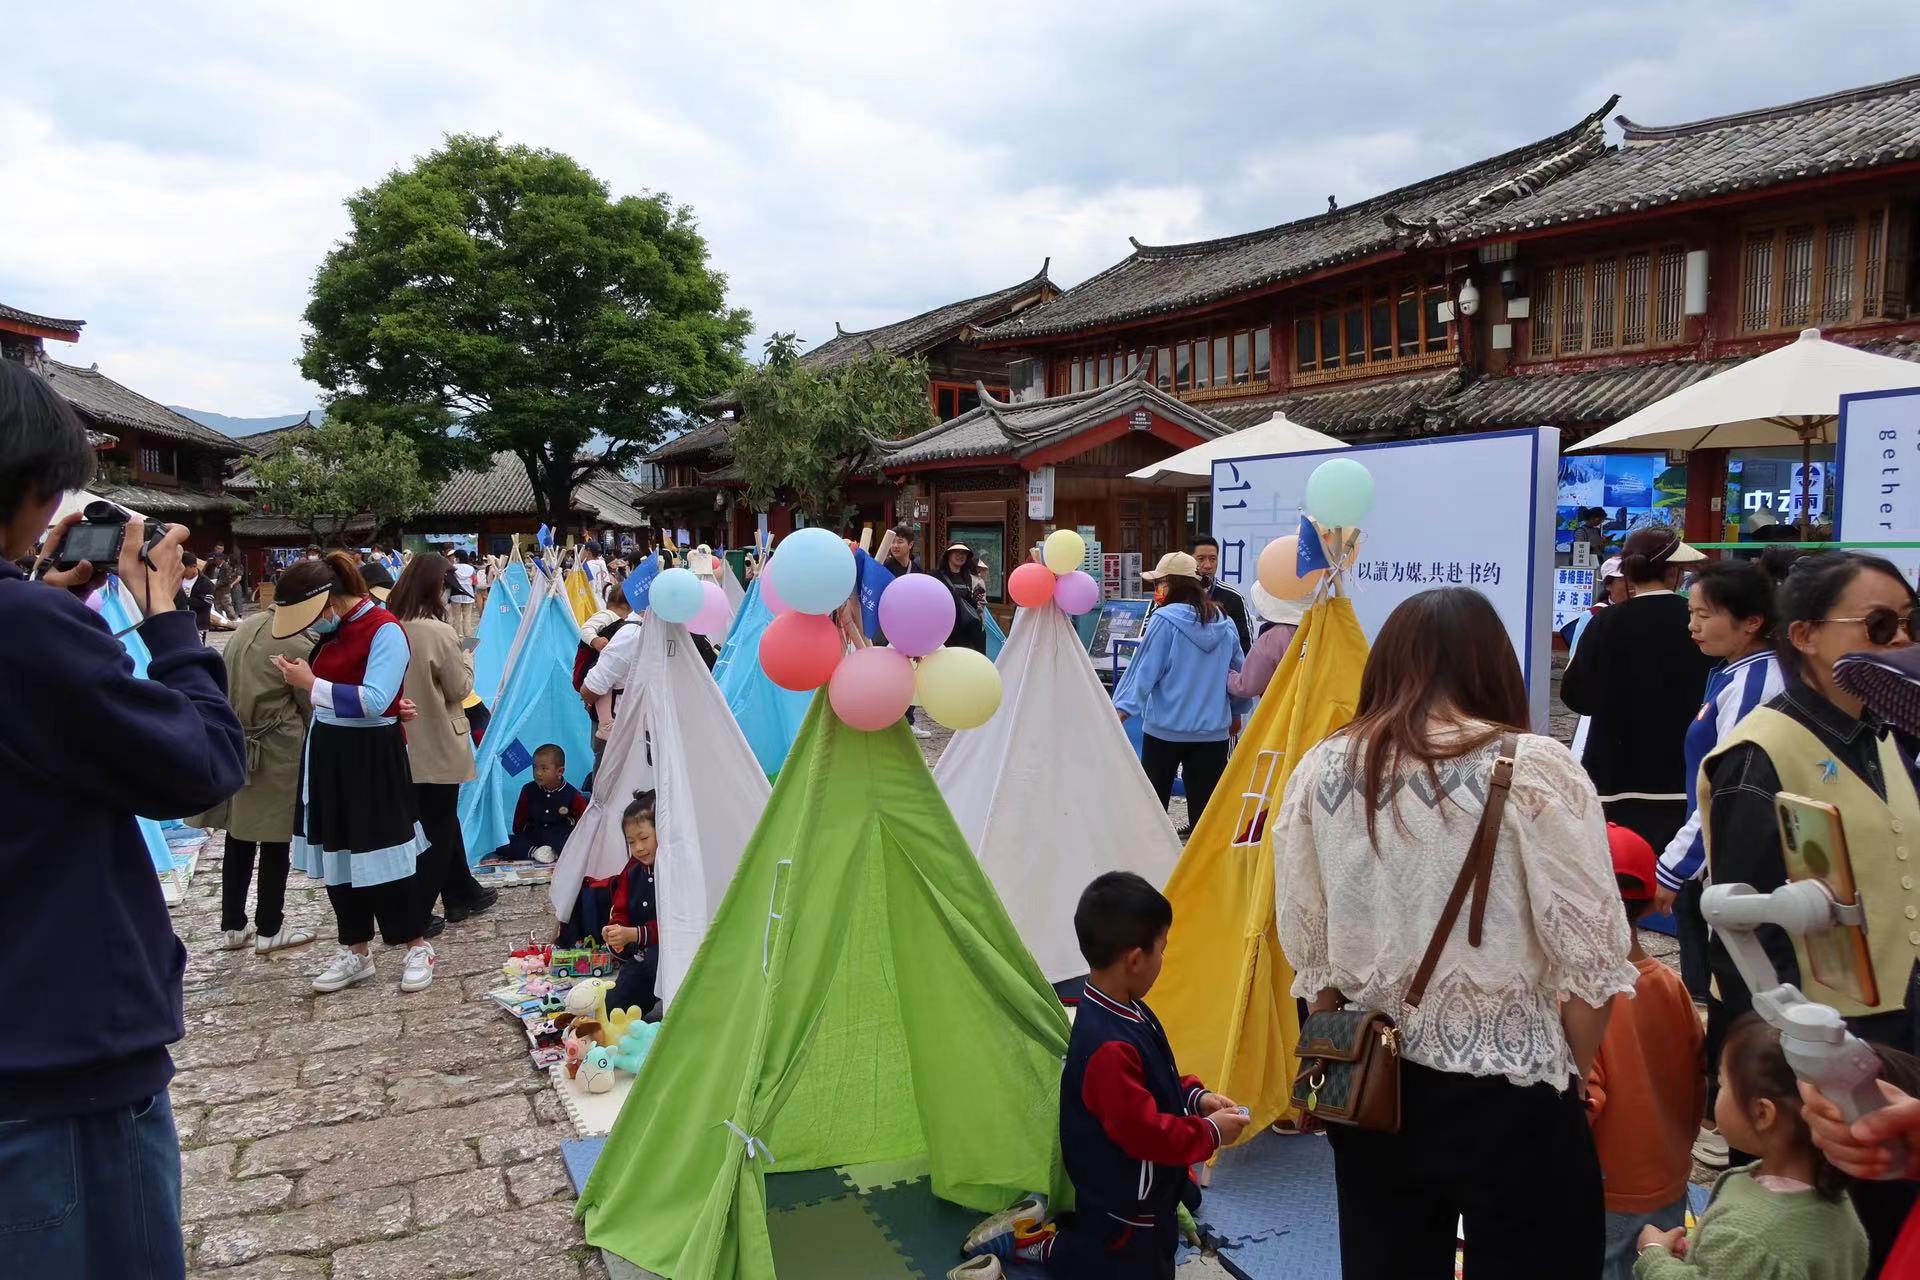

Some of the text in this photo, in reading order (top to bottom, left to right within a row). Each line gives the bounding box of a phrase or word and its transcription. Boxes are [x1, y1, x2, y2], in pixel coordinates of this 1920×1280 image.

[1559, 570, 1593, 585] 香格里拉
[1557, 591, 1592, 607] 泸沽湖
